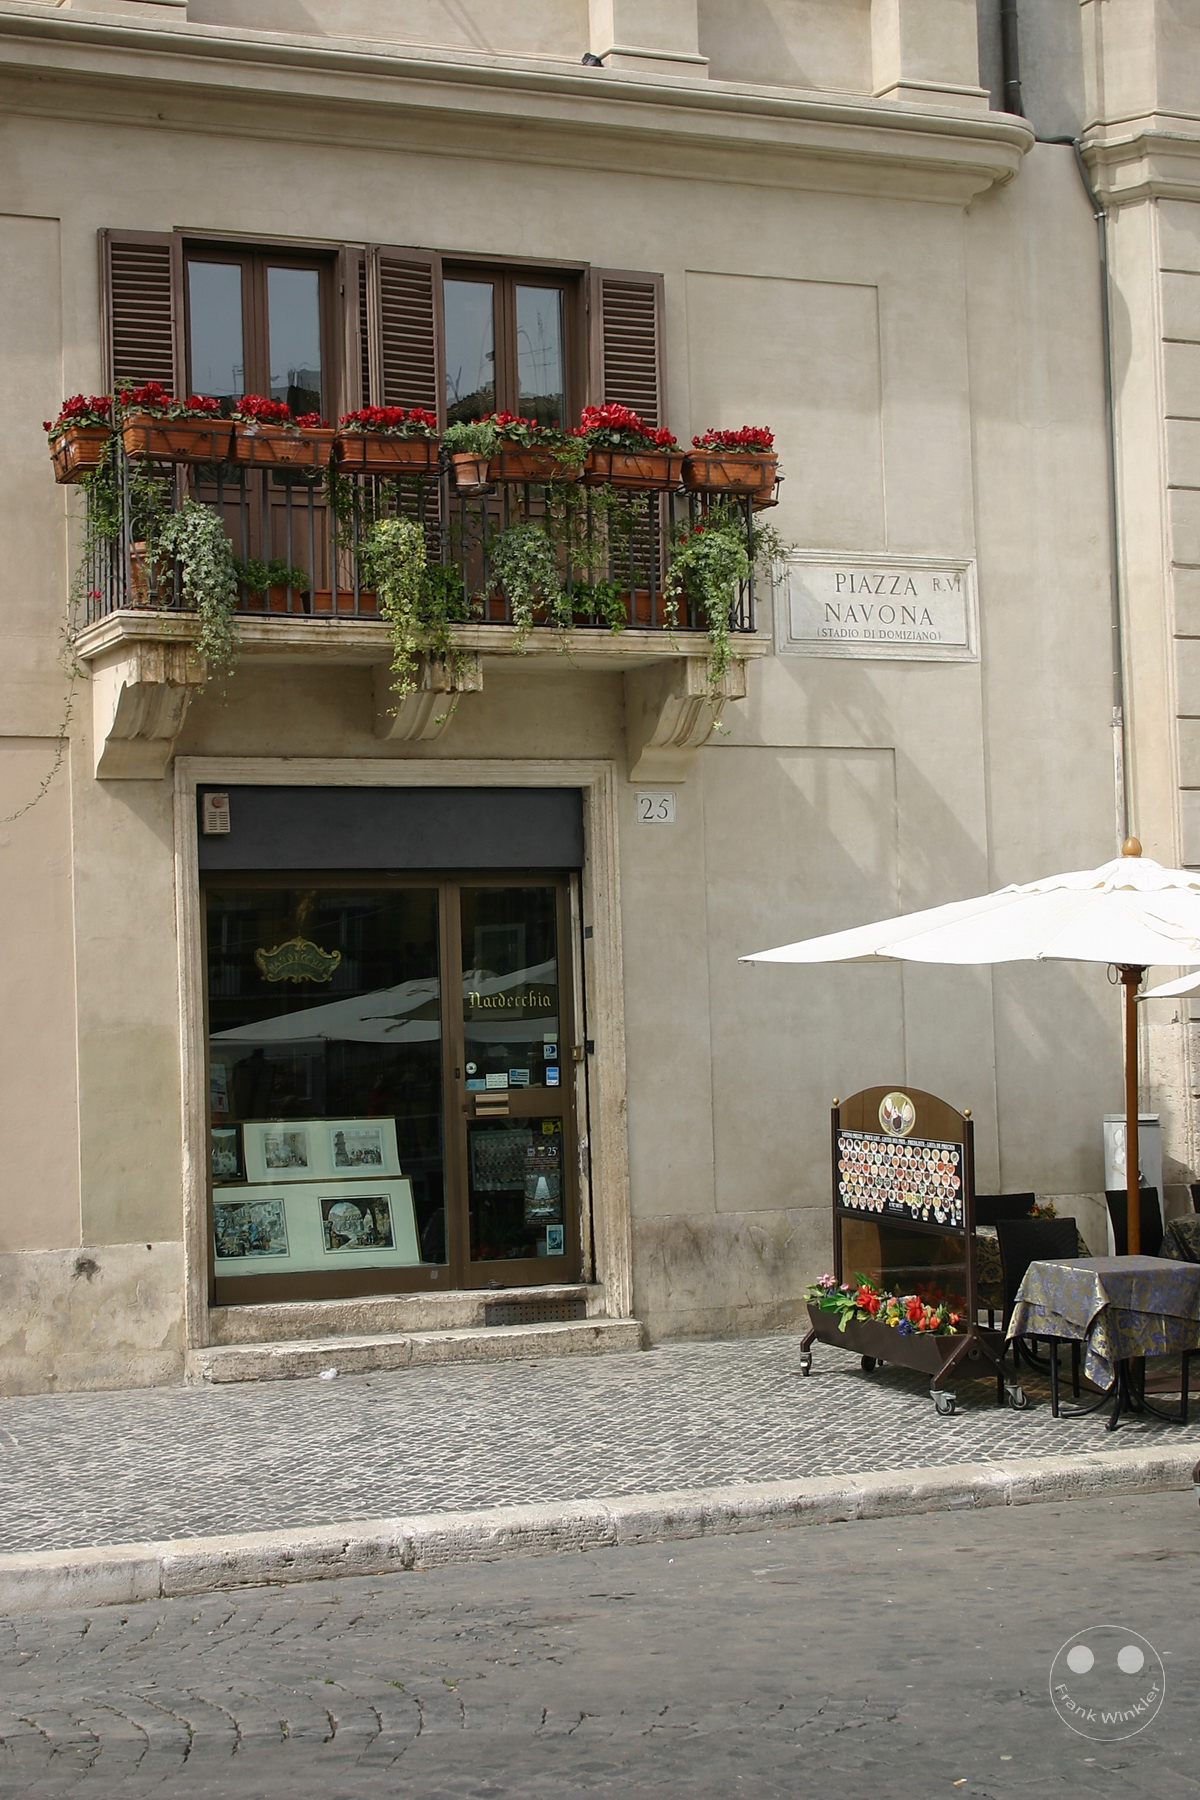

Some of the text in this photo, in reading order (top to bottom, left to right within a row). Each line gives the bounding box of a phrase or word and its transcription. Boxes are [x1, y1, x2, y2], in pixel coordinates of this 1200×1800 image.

[835, 573, 918, 596] PIAZZA
[825, 602, 933, 626] NAVONA
[817, 627, 942, 641] (STADIO DI DOMIZIANO)
[640, 797, 669, 820] 25
[468, 990, 552, 1008] Nardecchia
